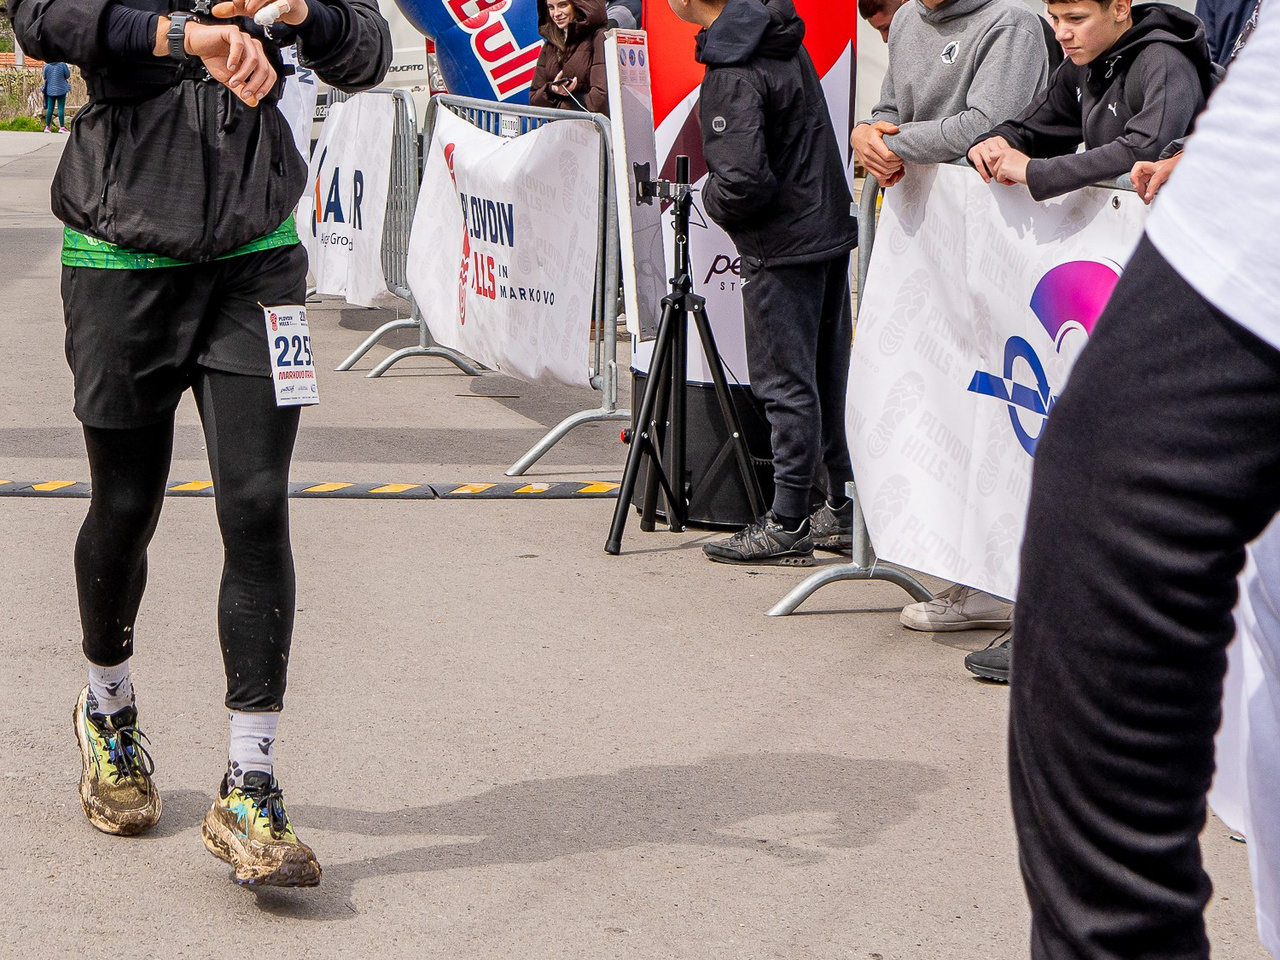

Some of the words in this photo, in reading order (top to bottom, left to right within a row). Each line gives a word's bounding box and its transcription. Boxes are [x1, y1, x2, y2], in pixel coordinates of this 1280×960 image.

[388, 64, 424, 72] DUCATO
[499, 265, 508, 279] IN
[501, 285, 555, 307] MARKOVO
[278, 371, 304, 380] MARKOVO
